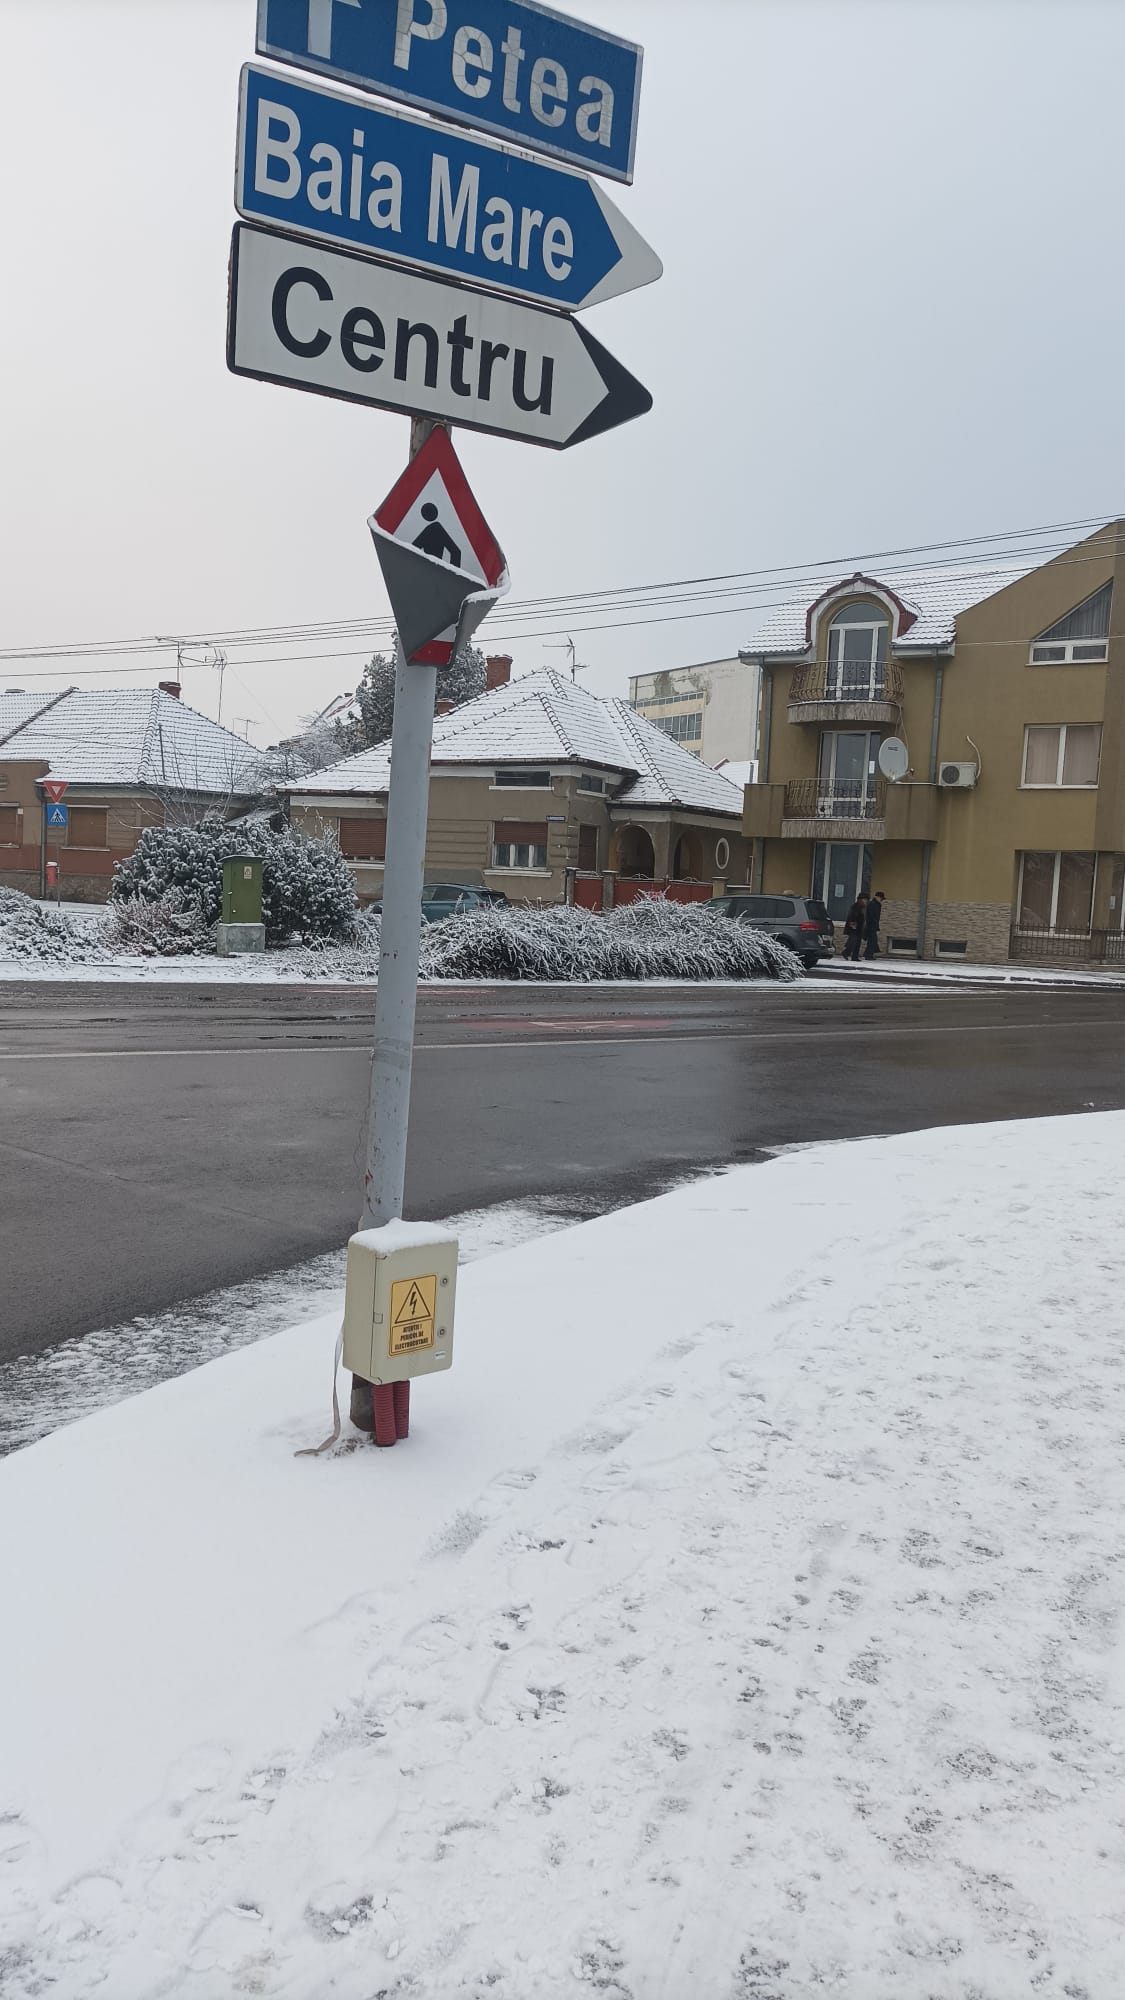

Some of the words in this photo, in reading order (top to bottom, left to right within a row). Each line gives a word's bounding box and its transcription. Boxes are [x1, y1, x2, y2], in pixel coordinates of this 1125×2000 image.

[393, 0, 615, 148] Petea
[254, 97, 402, 233] Baia
[427, 152, 575, 282] Mare
[271, 266, 554, 416] Centru
